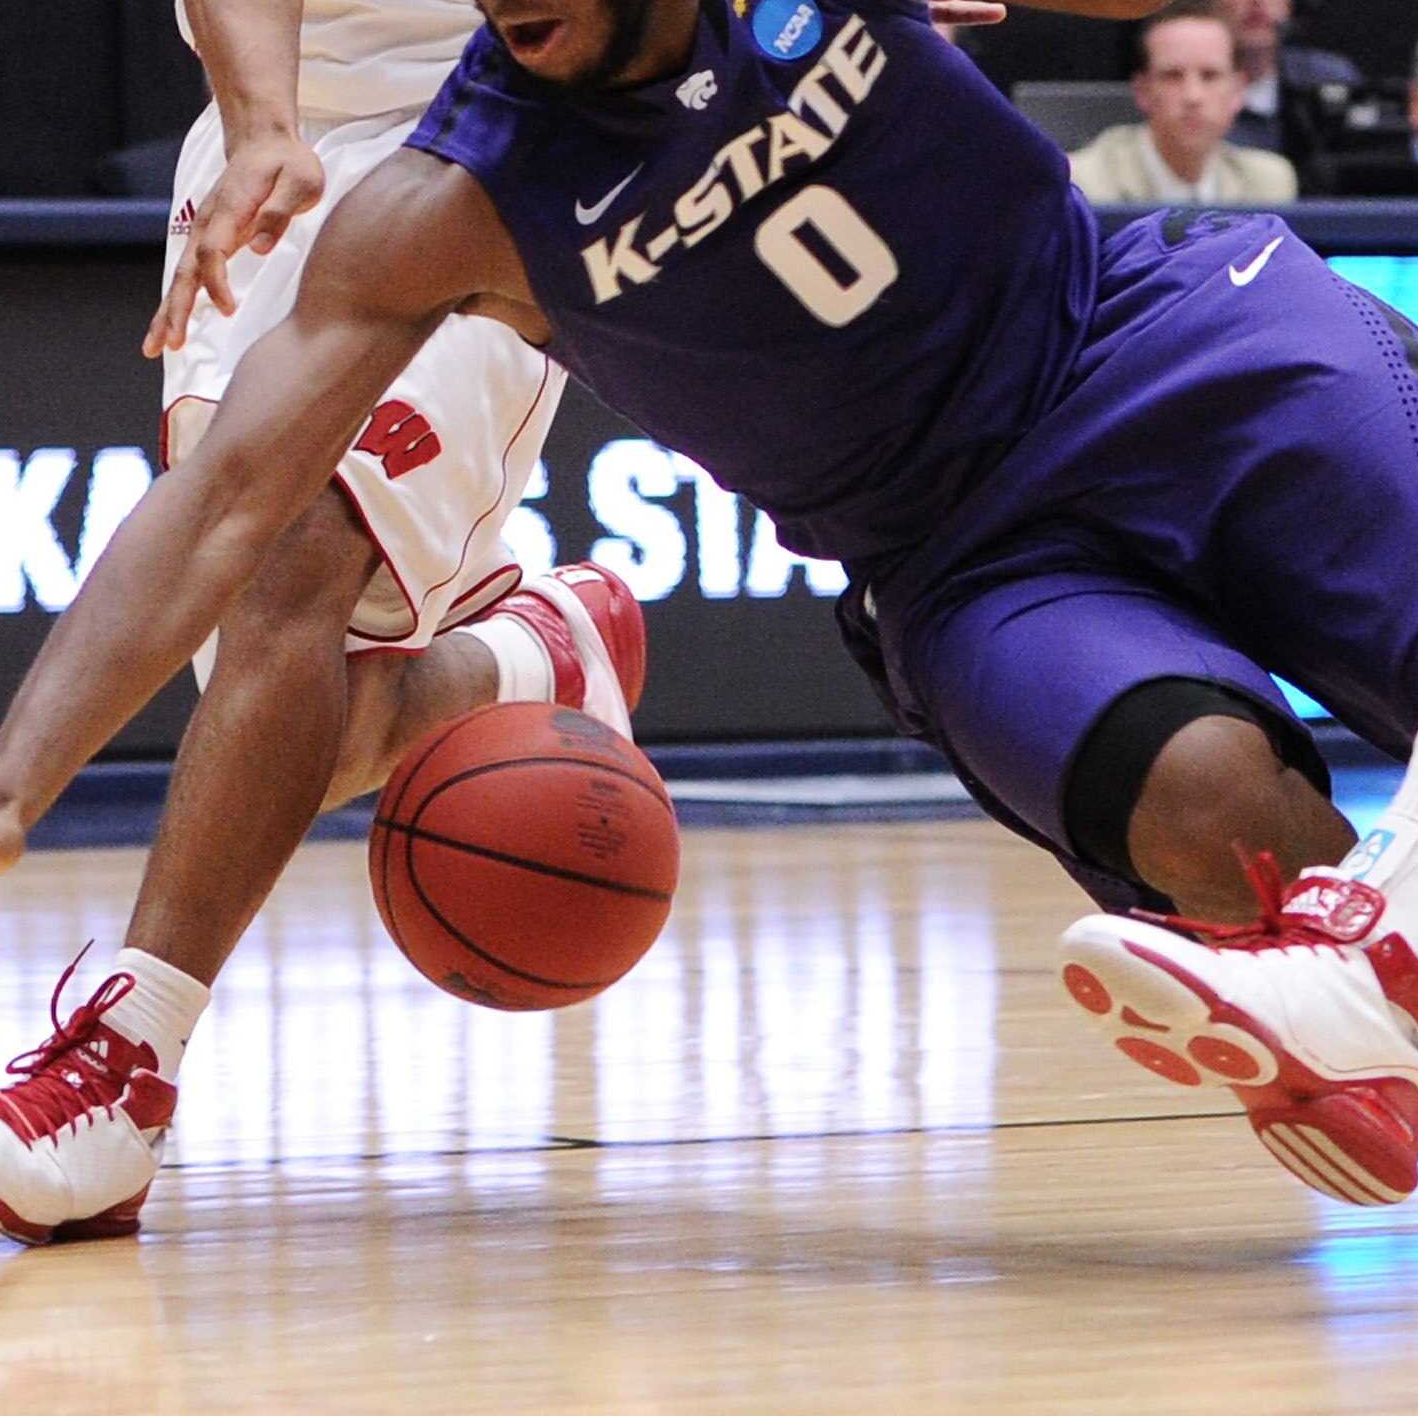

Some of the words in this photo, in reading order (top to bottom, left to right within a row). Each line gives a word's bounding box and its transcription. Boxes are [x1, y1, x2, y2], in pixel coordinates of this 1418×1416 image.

[773, 3, 815, 54] NCAA
[581, 14, 887, 305] K-STATE
[754, 184, 899, 328] 0
